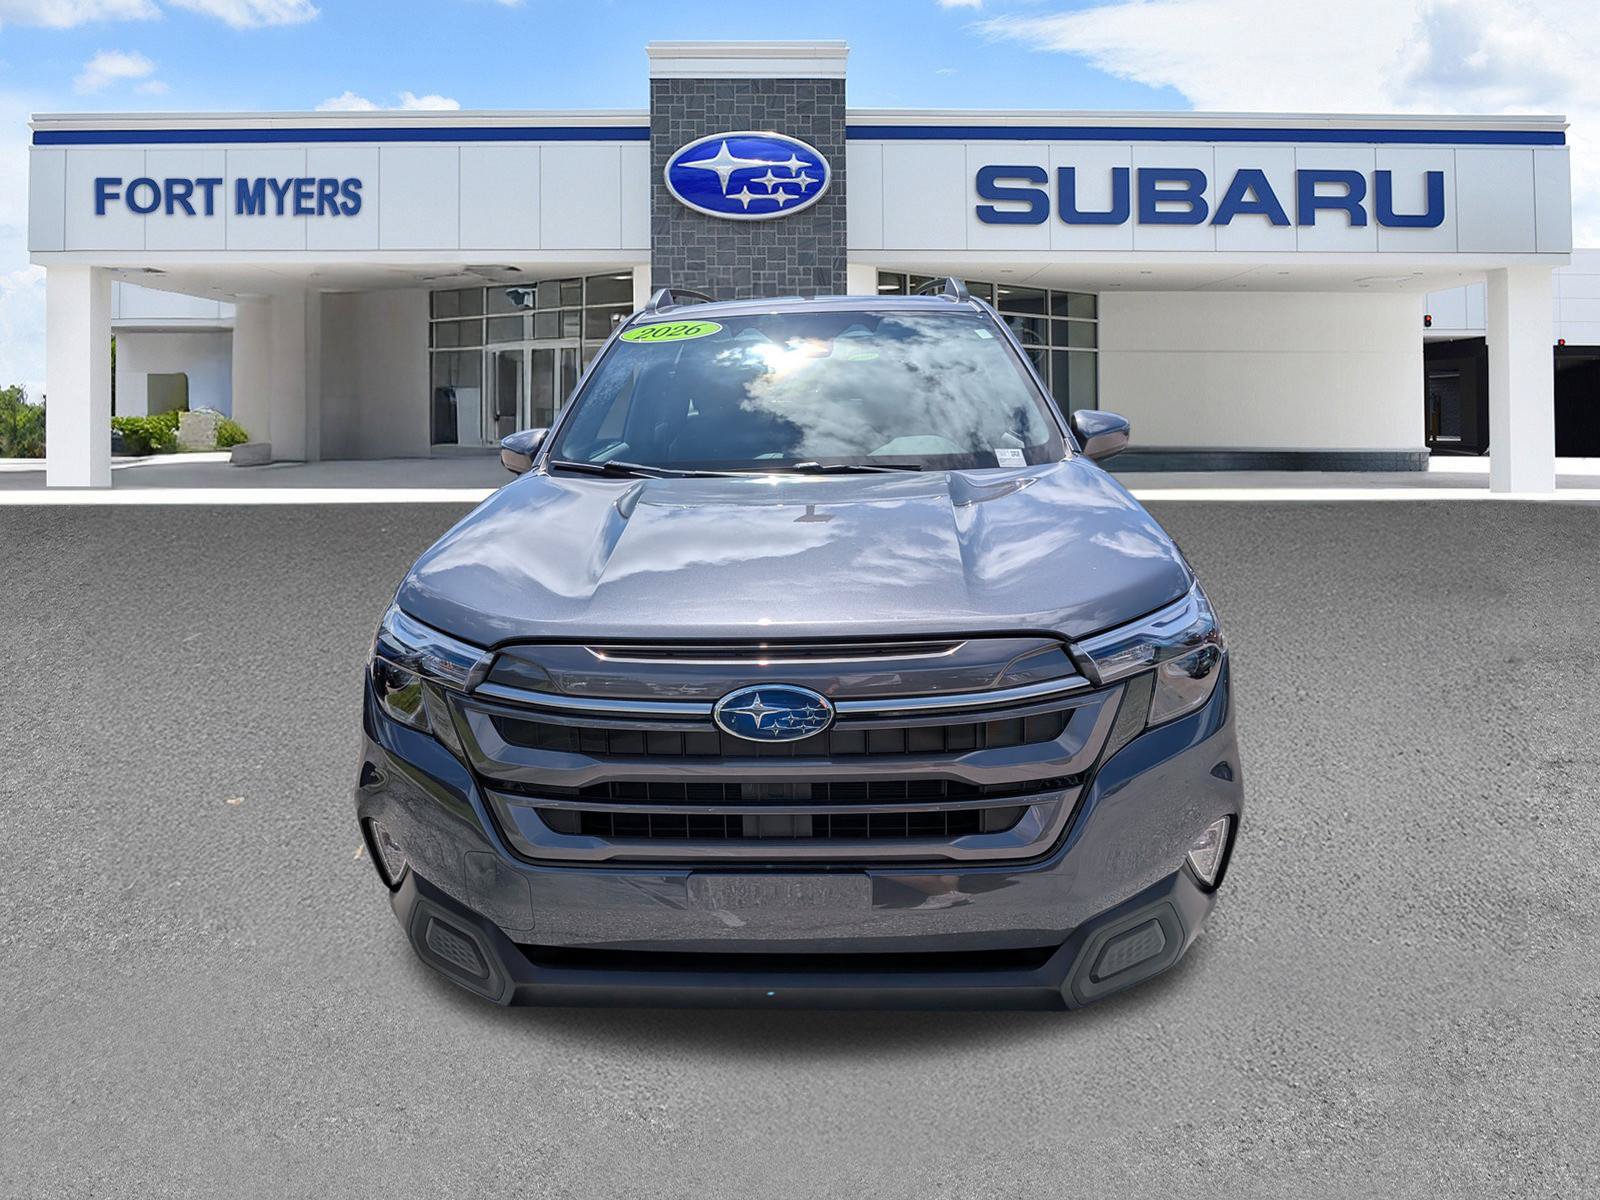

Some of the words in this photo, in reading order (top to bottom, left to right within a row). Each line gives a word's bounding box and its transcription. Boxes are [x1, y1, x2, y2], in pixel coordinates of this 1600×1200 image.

[94, 177, 222, 216] FORT
[235, 177, 363, 216] MYERS
[975, 165, 1445, 228] SUBARU
[633, 323, 707, 340] 2026
